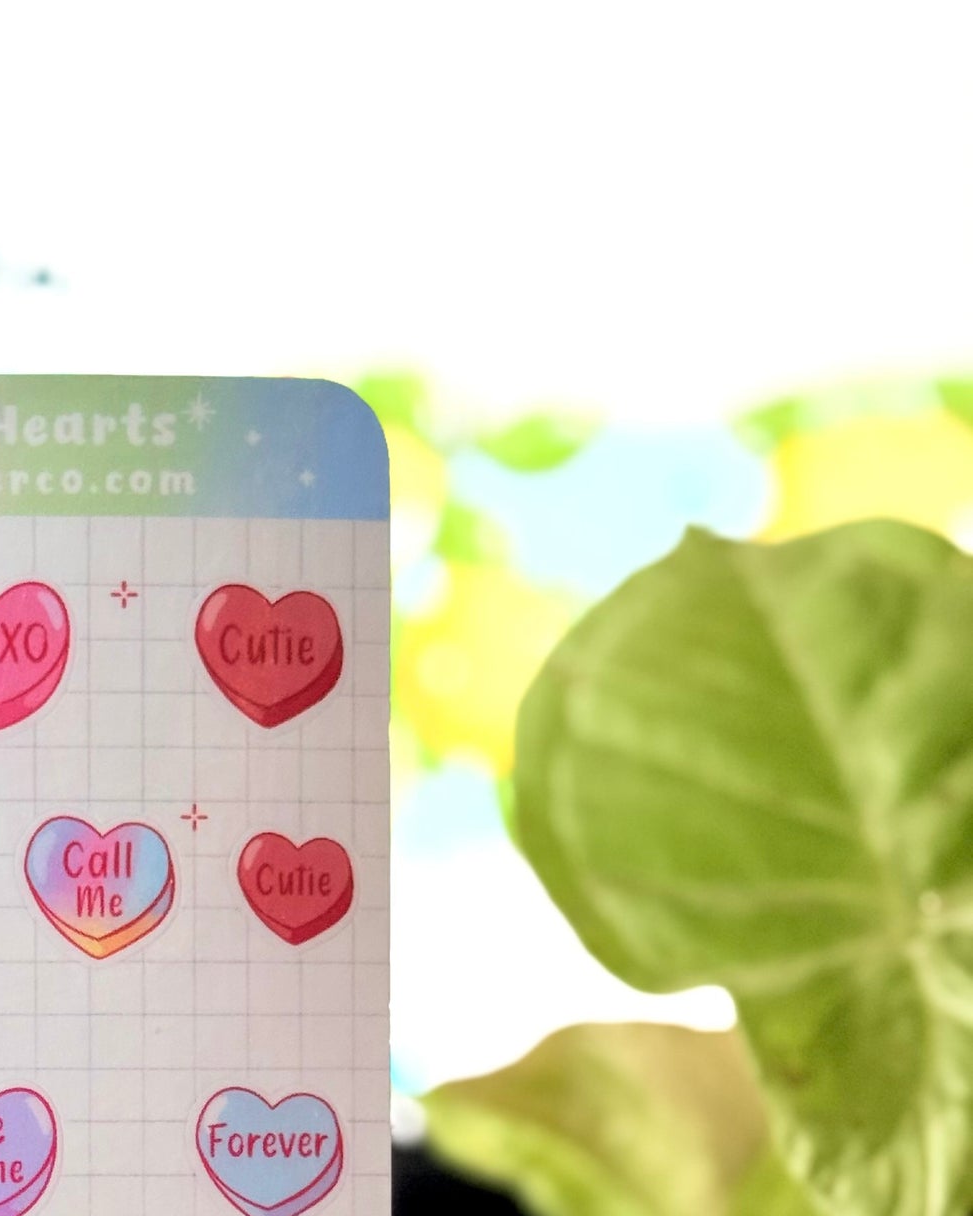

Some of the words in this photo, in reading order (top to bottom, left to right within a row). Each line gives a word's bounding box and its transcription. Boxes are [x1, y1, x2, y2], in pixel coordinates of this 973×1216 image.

[220, 623, 315, 666] Cutie
[62, 841, 133, 880] Call
[256, 862, 332, 897] Cutie
[77, 883, 124, 918] Me
[207, 1122, 329, 1159] Forever
